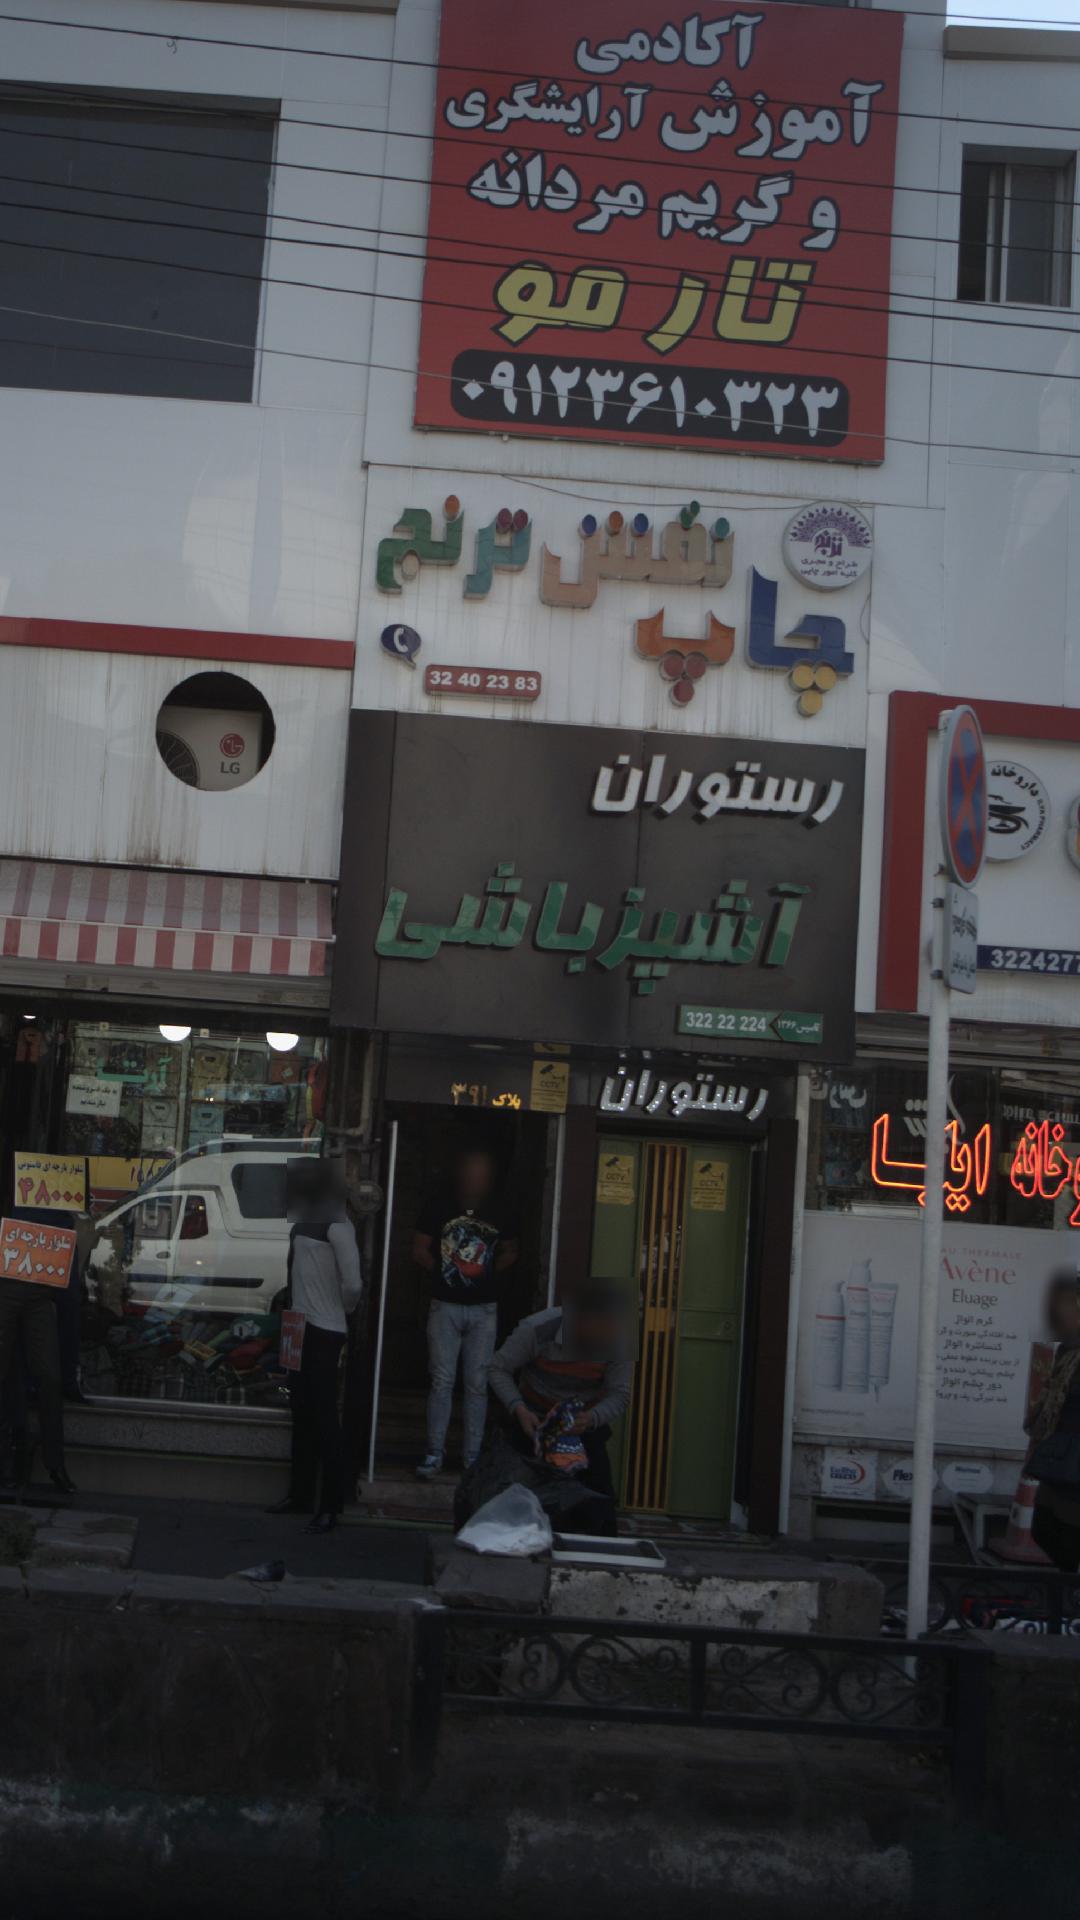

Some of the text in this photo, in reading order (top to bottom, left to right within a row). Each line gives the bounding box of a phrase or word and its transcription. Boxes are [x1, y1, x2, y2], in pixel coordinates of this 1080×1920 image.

[575, 13, 764, 74] آکادمی
[445, 79, 886, 160] آموزش آرایشگری
[468, 149, 841, 250] و گریم مردانه
[491, 256, 817, 355] تار مو
[463, 361, 839, 438] ۰۹۱۲۳۶۱۰۳۲۳
[376, 494, 533, 600] ترنج
[430, 670, 538, 691] 32 40 23 83
[220, 761, 241, 775] LG
[591, 755, 845, 824] رستوران
[991, 765, 1039, 797] داروخانه
[686, 1011, 767, 1032] 322 22 224
[492, 1092, 521, 1110] پلاک
[600, 1066, 769, 1121] رستوران
[3, 1247, 66, 1277] ۳۸۰۰۰
[952, 1288, 998, 1310] Eluage
[892, 1468, 914, 1481] Flex
